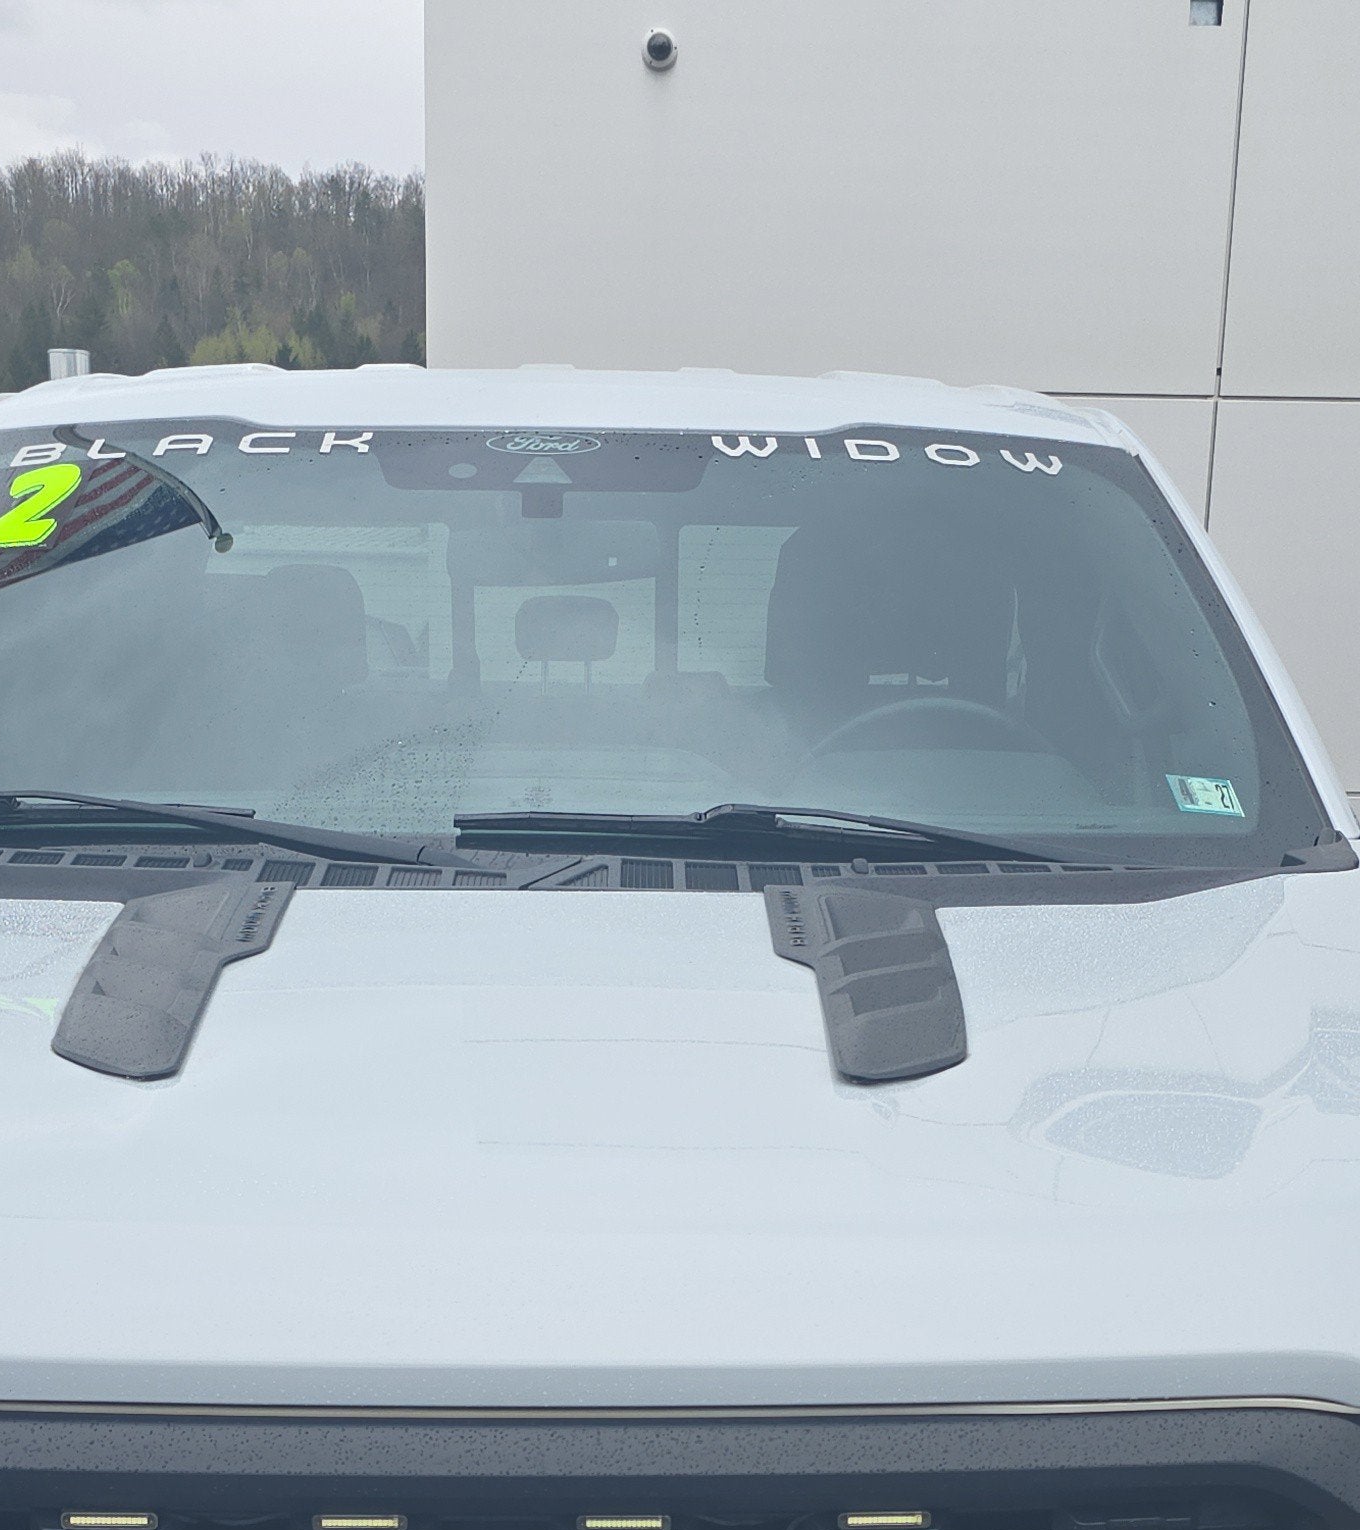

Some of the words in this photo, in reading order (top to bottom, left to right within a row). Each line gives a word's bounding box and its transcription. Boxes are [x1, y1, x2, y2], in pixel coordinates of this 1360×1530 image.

[9, 432, 374, 468] BLACK
[711, 435, 1063, 476] WIDOW
[506, 436, 581, 451] Ford
